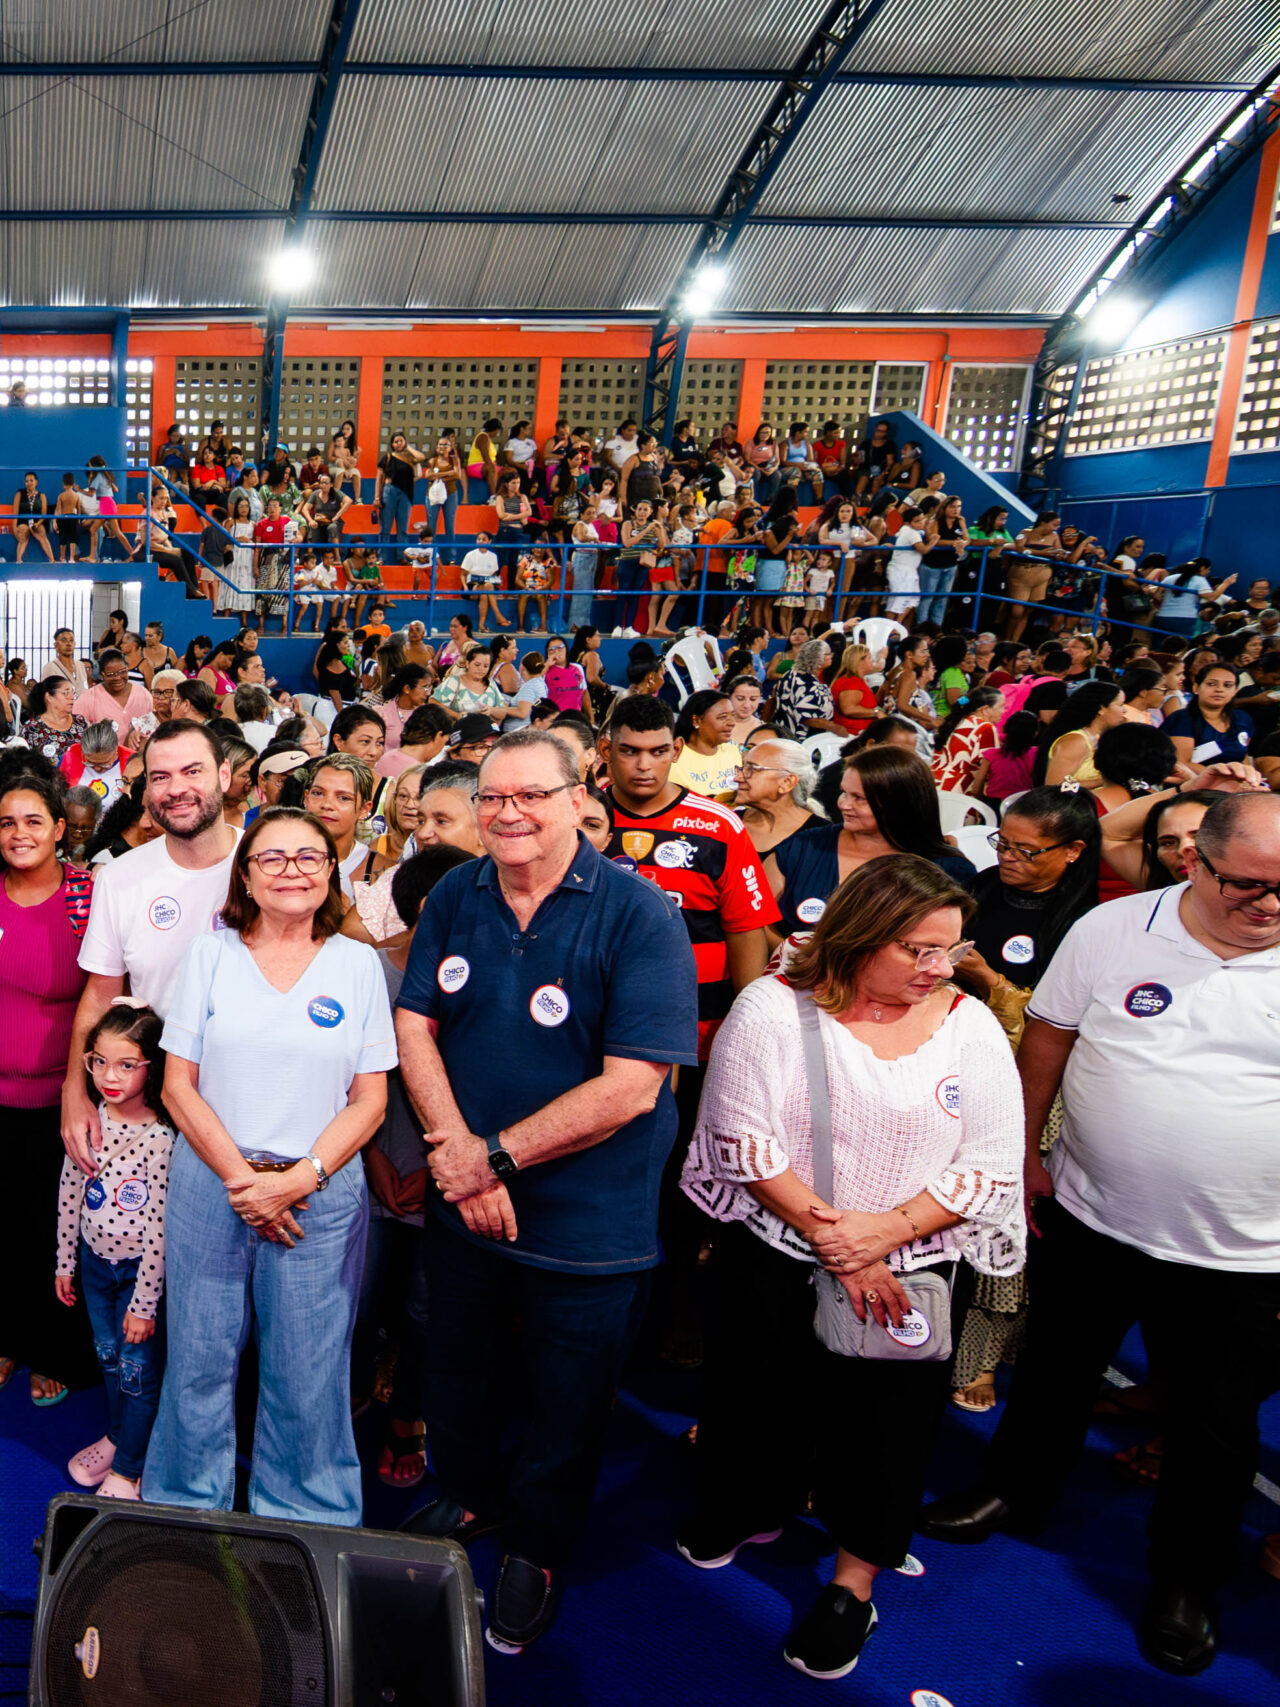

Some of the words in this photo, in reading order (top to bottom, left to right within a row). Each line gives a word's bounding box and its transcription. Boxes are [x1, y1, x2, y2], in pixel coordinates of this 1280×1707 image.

[672, 816, 720, 833] pixbet
[660, 849, 680, 861] CHICO
[154, 909, 175, 918] CHICO
[1012, 941, 1030, 955] CHICO
[444, 966, 465, 976] CHICO
[1135, 990, 1154, 998] JHC
[541, 993, 563, 1013] CHICO
[1132, 997, 1164, 1007] CHICO
[313, 1002, 339, 1017] CHICO
[123, 1184, 137, 1192] JHC
[121, 1190, 142, 1200] CHICO
